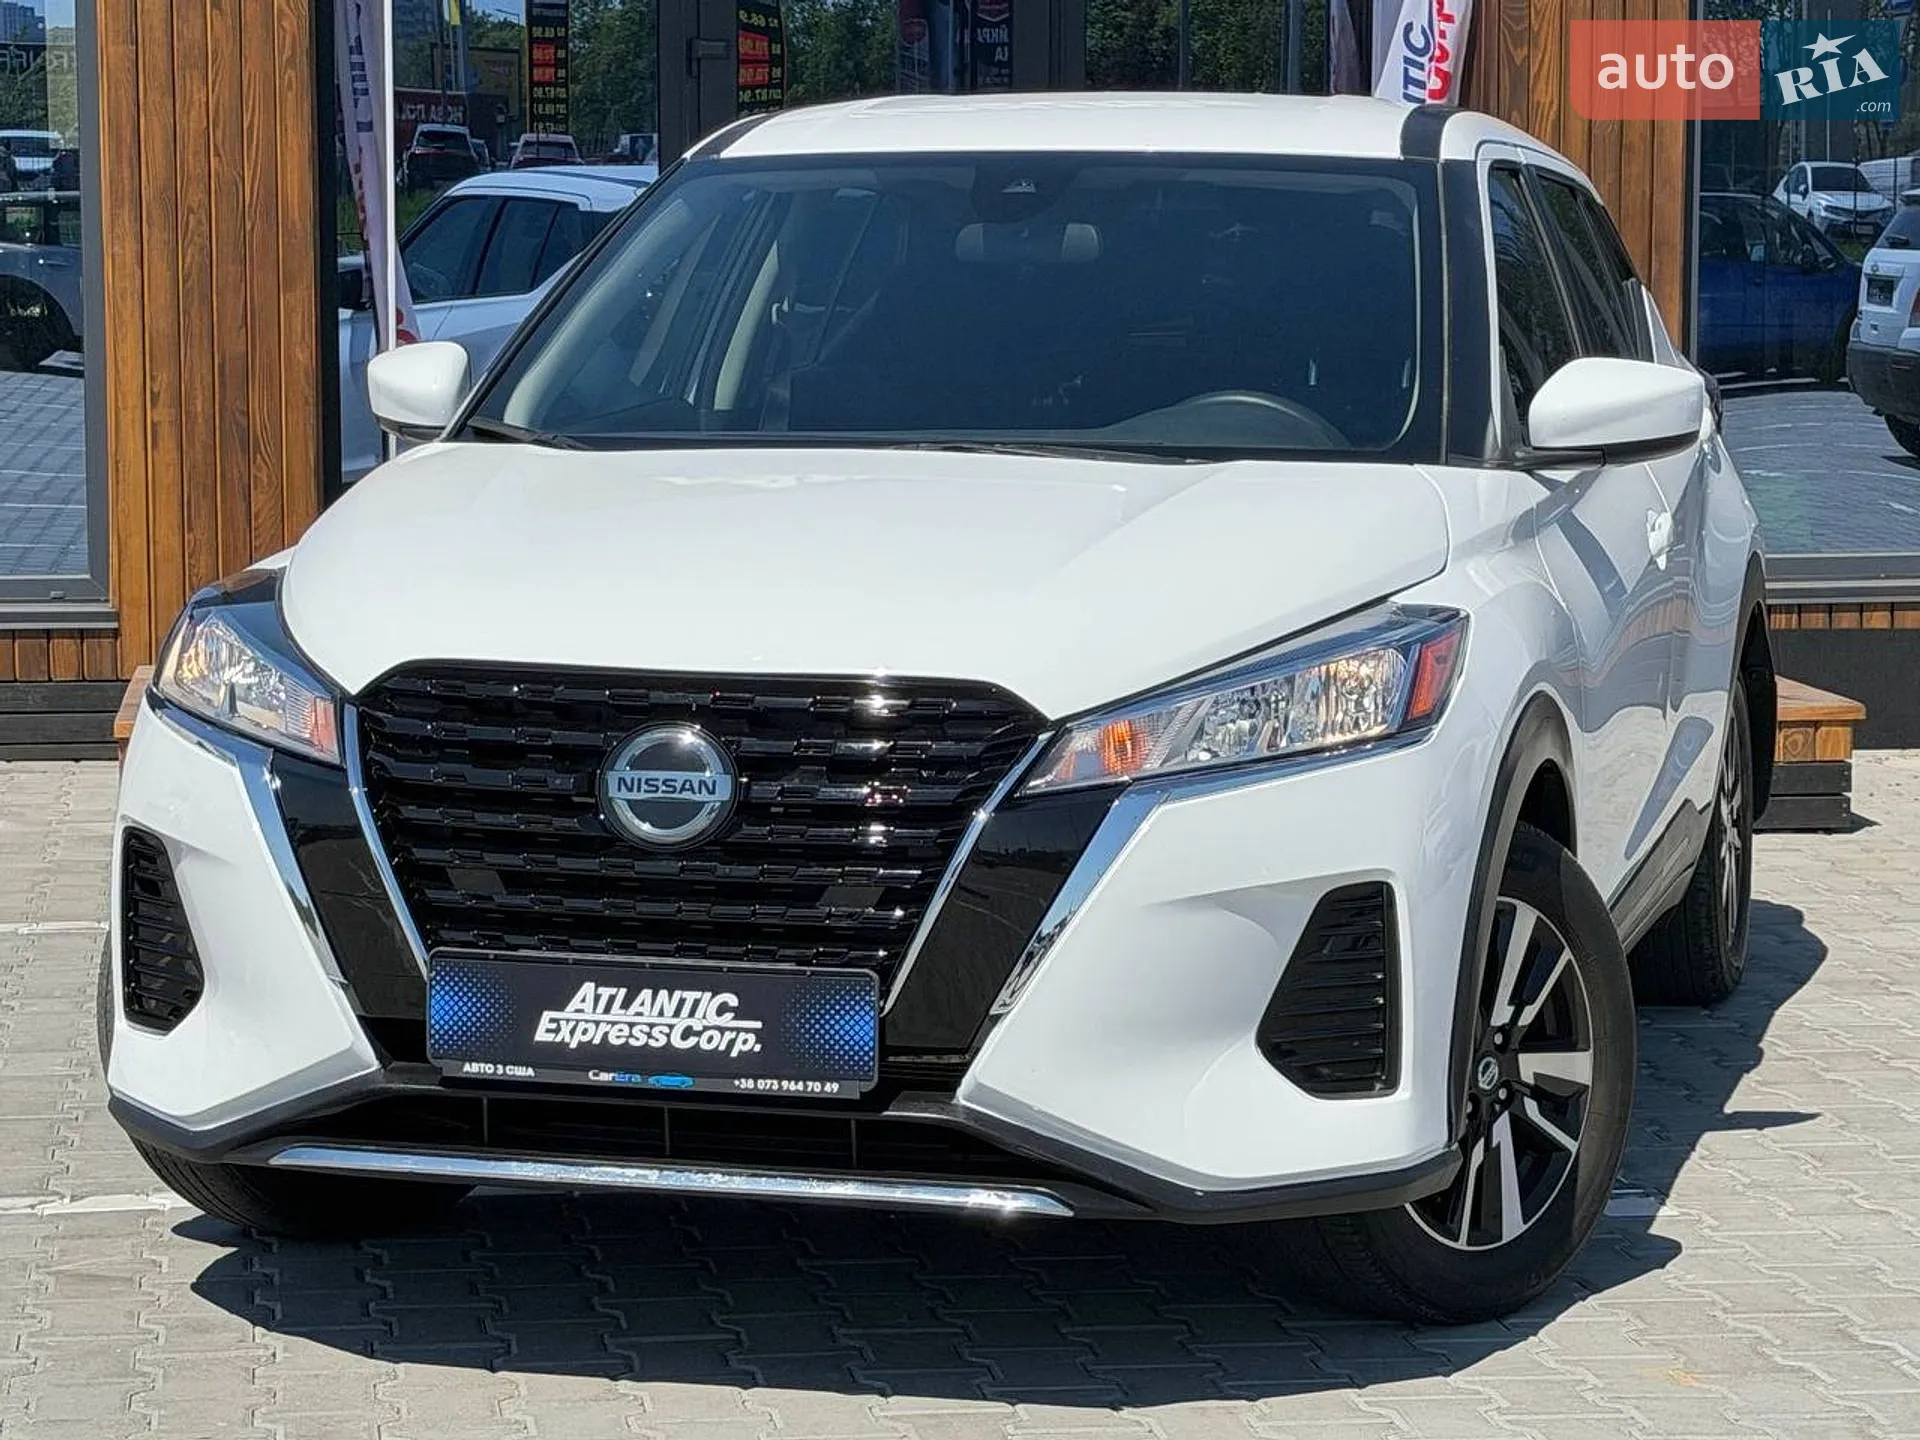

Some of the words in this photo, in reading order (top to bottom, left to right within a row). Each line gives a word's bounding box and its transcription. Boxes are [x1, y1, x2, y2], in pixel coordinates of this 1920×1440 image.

[617, 776, 717, 795] NISSAN
[565, 981, 739, 1026] ATLANTIC
[534, 1010, 763, 1057] ExpressCorp.
[462, 1062, 495, 1074] АВТО
[505, 1065, 535, 1077] США
[733, 1078, 755, 1089] +38
[757, 1079, 779, 1090] 073
[806, 1081, 821, 1093] 70
